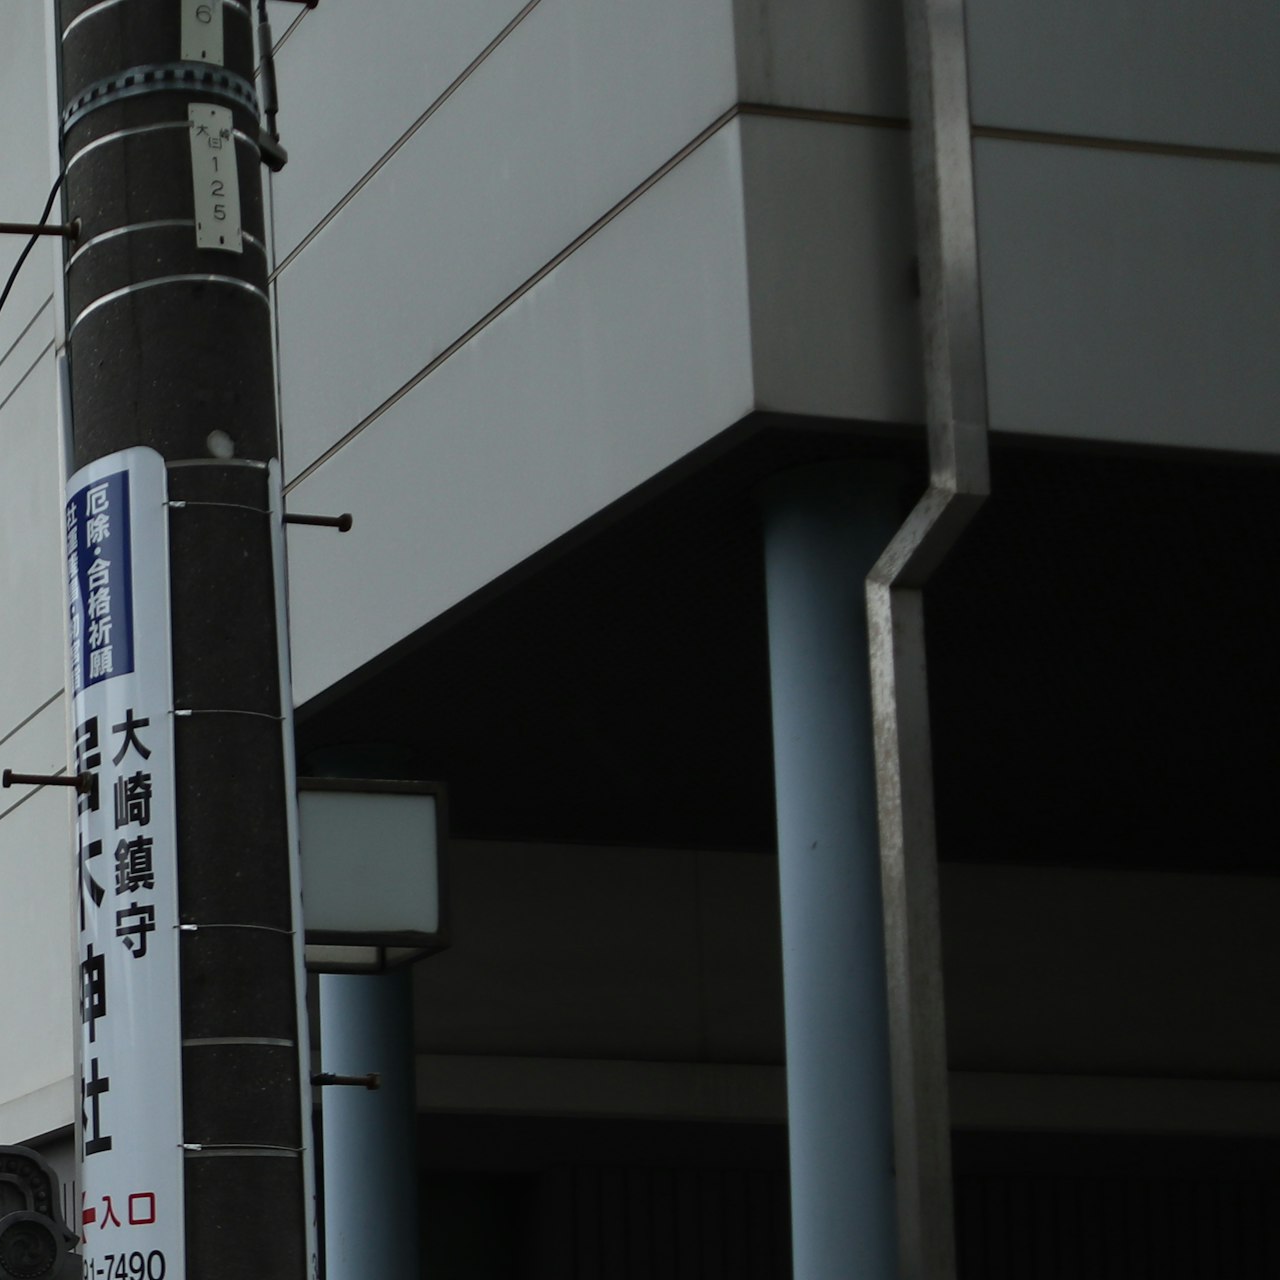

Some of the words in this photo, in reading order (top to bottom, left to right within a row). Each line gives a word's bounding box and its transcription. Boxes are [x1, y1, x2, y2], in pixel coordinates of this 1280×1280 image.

[112, 708, 156, 960] 大崎鎮守
[100, 1192, 156, 1230] 入口
